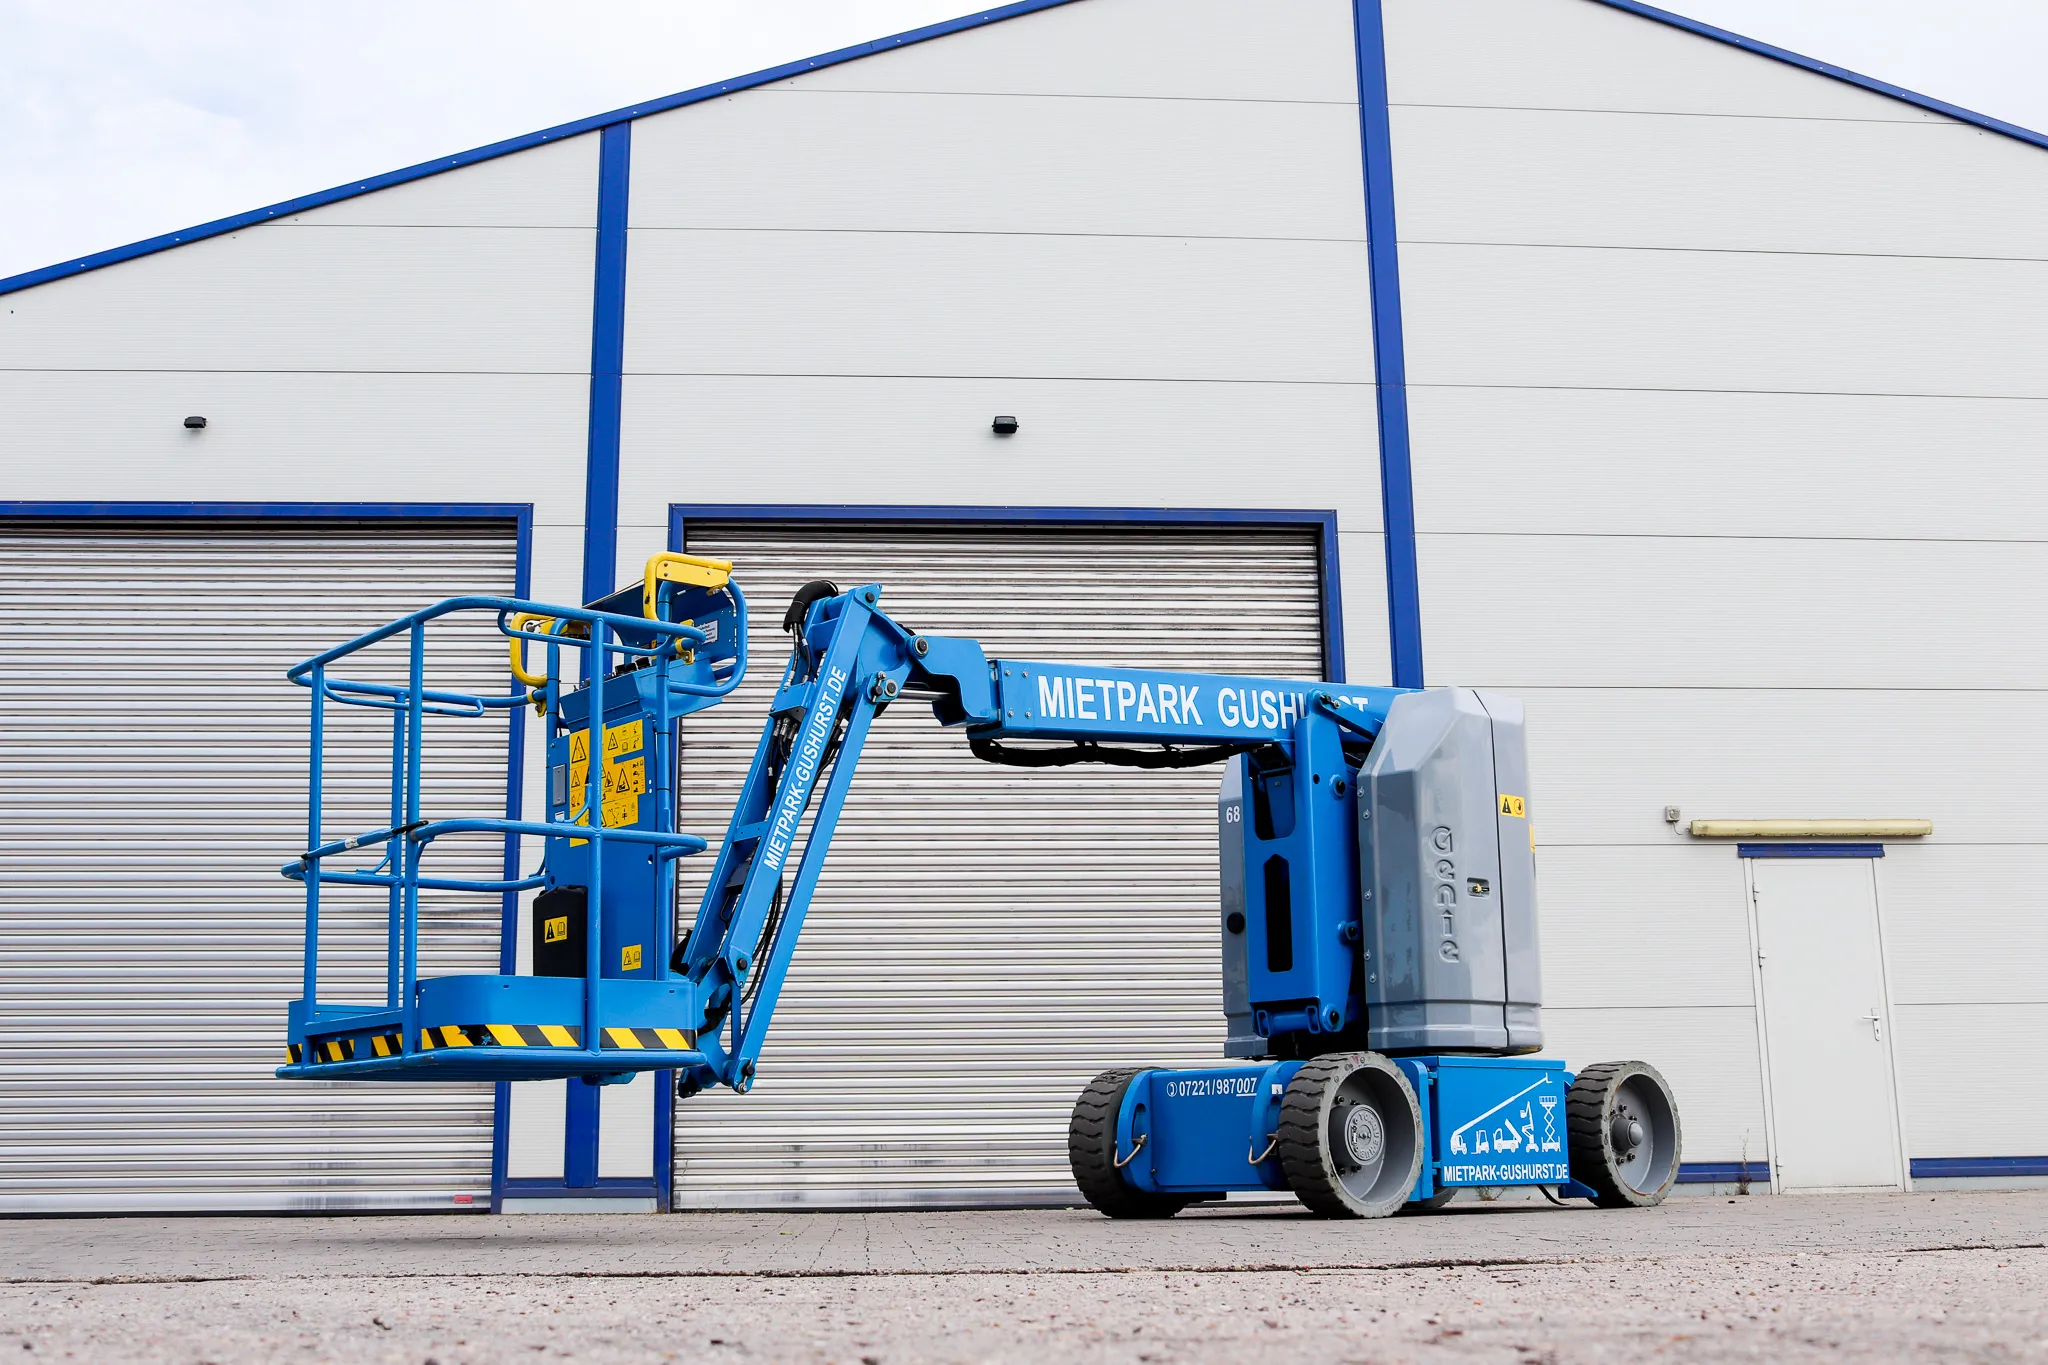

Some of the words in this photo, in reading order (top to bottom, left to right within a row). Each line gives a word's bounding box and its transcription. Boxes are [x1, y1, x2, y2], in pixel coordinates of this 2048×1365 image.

[1037, 675, 1204, 726] MIETPARK
[1217, 686, 1369, 733] GUSHT
[763, 665, 847, 871] MIETPARK-GUSHURST.DE
[1226, 805, 1241, 824] 68
[1179, 1077, 1258, 1097] 07221/987007
[1443, 1163, 1569, 1182] MIETPARK-GUSHURST.DE
